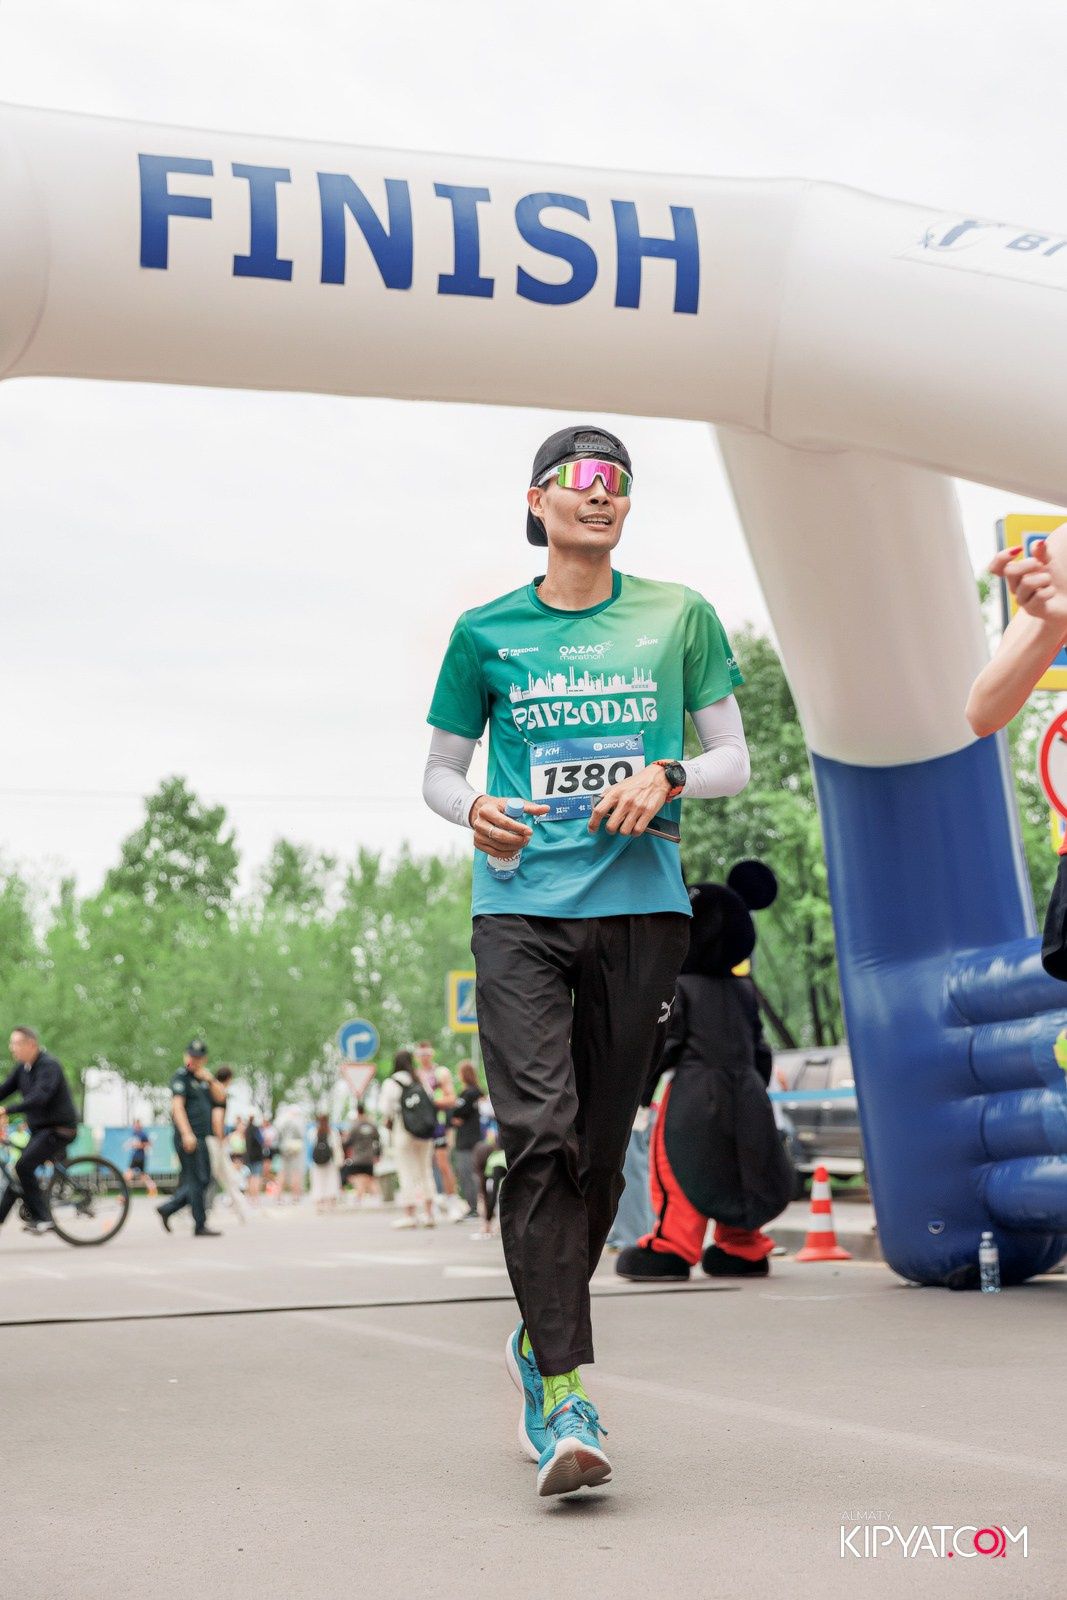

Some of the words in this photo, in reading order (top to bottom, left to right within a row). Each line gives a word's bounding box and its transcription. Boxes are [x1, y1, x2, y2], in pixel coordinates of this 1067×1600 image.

[137, 152, 701, 315] FINISH
[510, 646, 539, 654] FREEDOM
[559, 644, 604, 655] QAZAQ
[559, 653, 605, 661] marathon
[511, 697, 658, 732] PAVLODAR
[545, 747, 561, 757] KM
[544, 760, 633, 796] 1380
